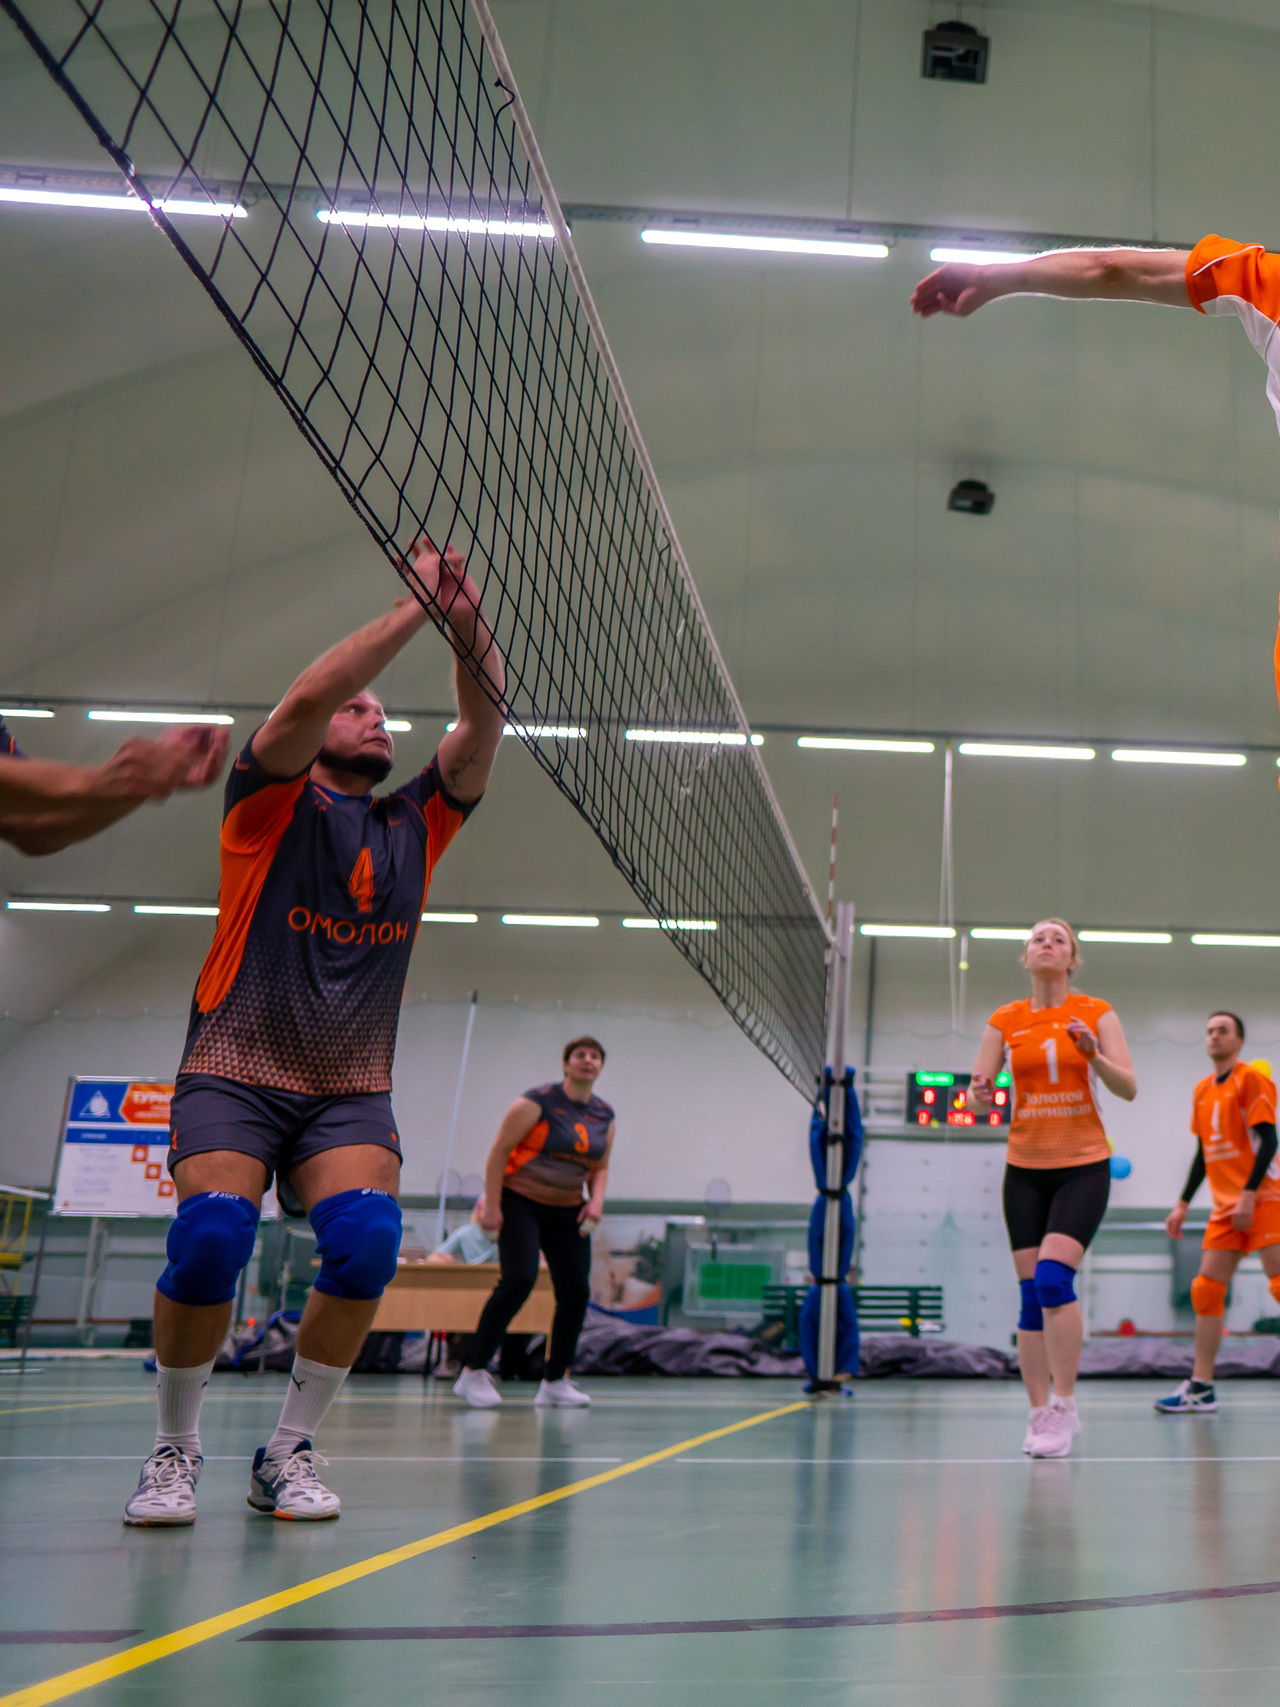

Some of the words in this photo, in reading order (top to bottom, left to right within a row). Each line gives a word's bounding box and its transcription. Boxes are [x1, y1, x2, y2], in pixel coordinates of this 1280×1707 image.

[347, 847, 377, 914] 4
[287, 906, 409, 946] ОМОЛОН
[1039, 1037, 1059, 1085] 1
[573, 1122, 589, 1154] 3
